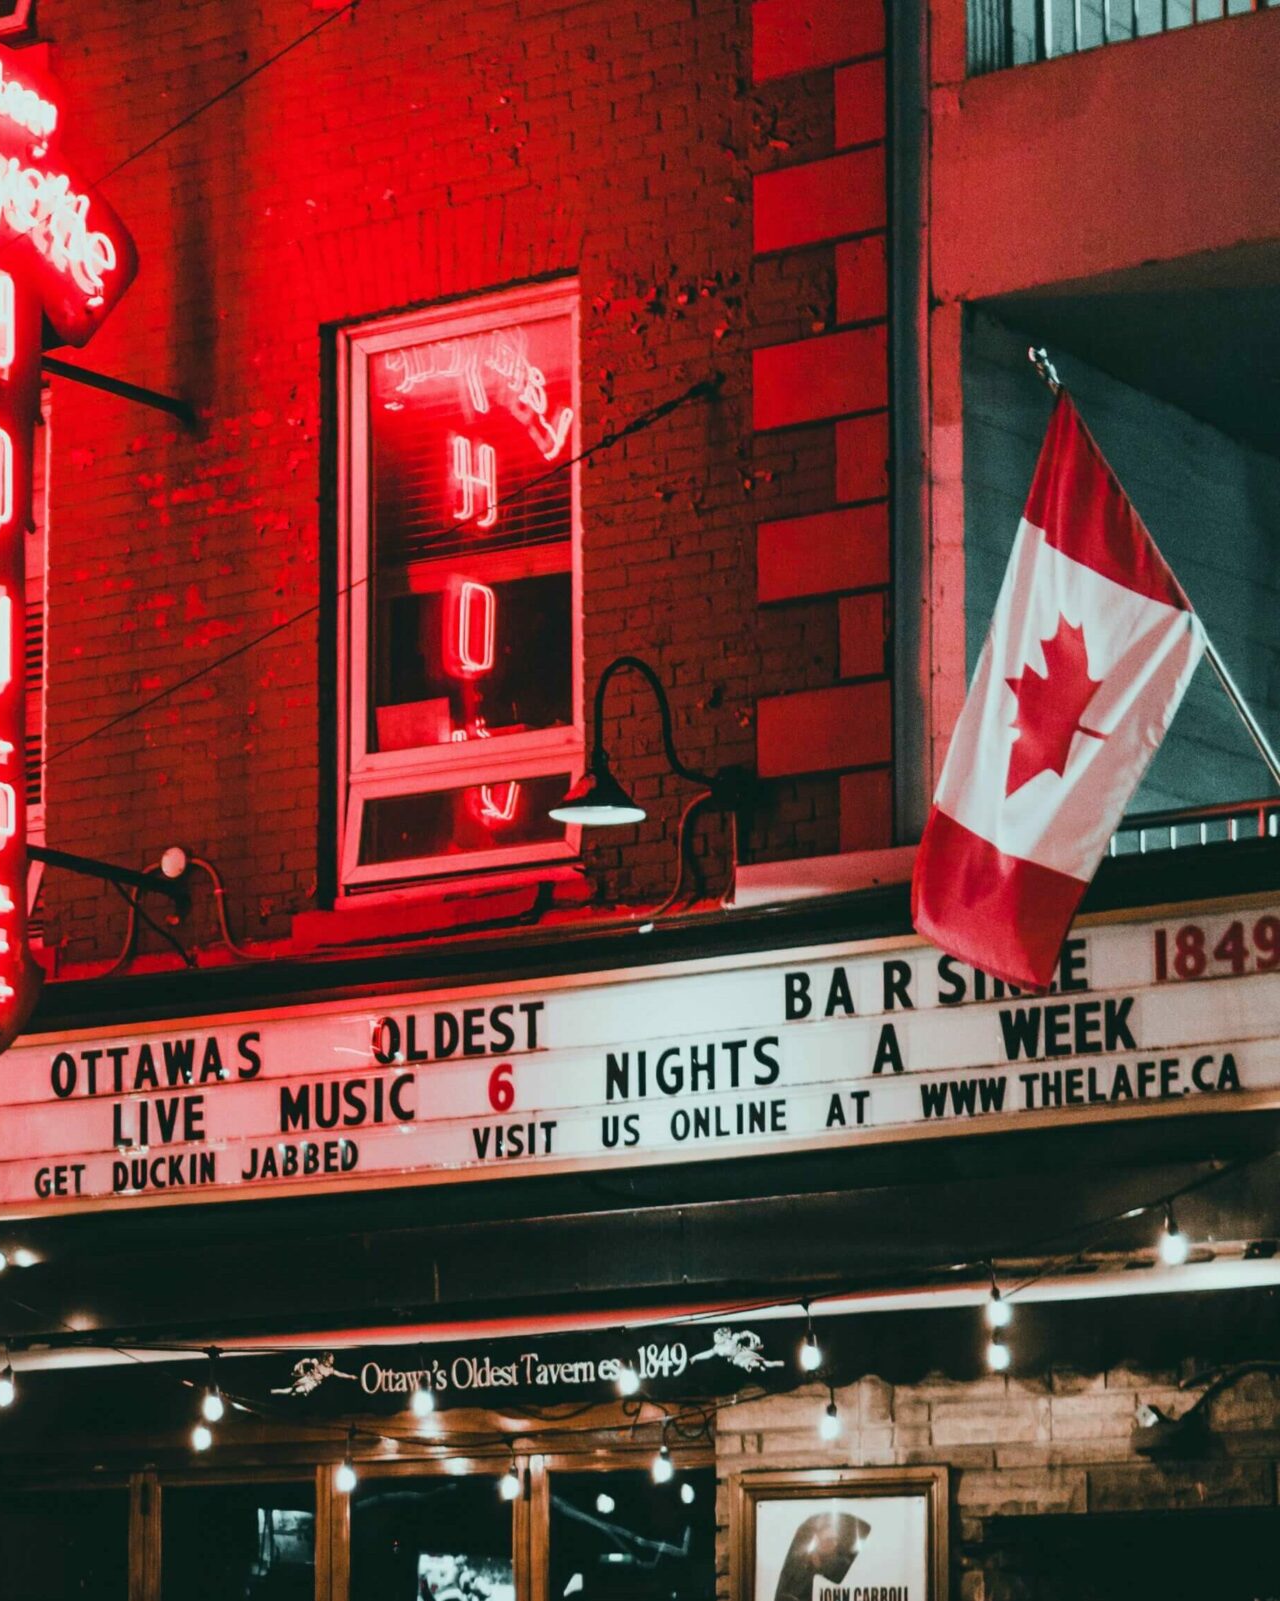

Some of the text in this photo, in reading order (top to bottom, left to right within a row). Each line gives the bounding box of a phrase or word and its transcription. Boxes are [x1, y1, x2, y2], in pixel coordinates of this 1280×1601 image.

[51, 915, 1280, 1098] OTTAWAS OLDEST BAR SIE 1849
[112, 997, 1137, 1148] LIVE MUSIC 6 NIGHTS A WEEK
[34, 1164, 86, 1199] GET
[112, 1151, 216, 1194] DUCKIN
[241, 1138, 359, 1181] JABBED
[473, 1121, 557, 1160] VISIT
[602, 1114, 640, 1148] US
[670, 1099, 787, 1141] ONLINE
[826, 1090, 870, 1128] AT
[451, 1357, 518, 1388] Oldest
[521, 1353, 596, 1384] Tavern
[637, 1342, 687, 1379] 1849
